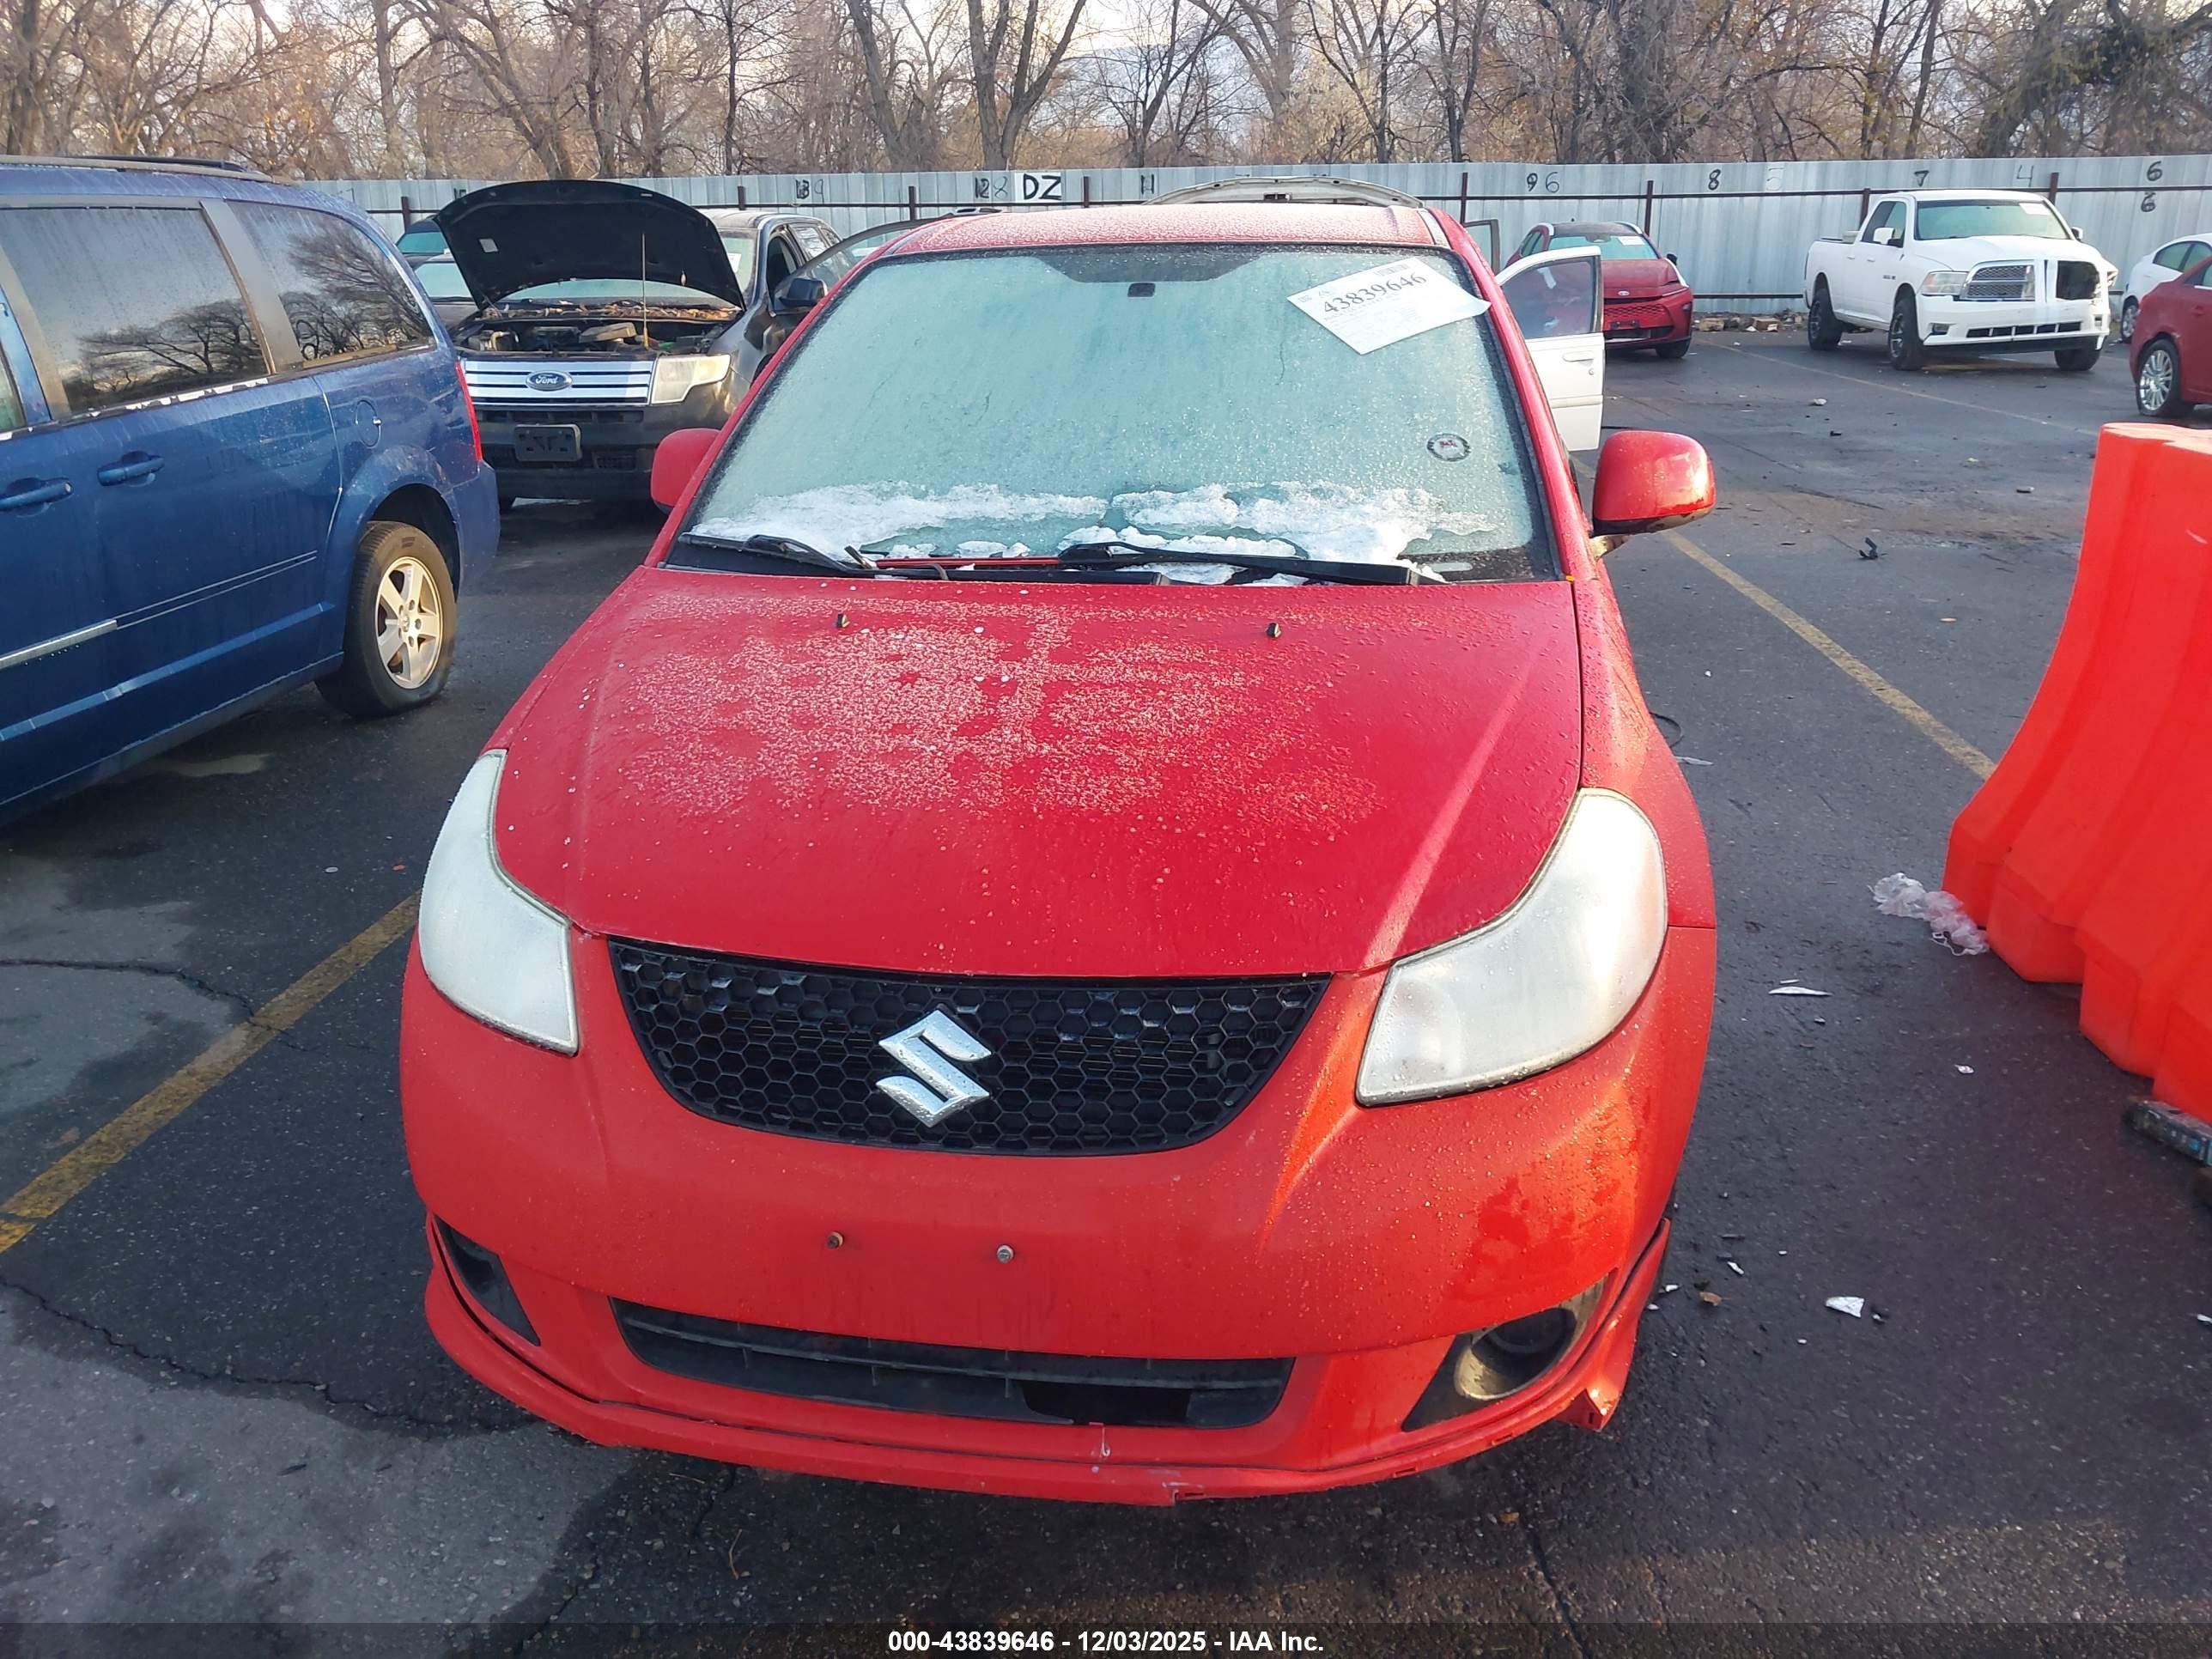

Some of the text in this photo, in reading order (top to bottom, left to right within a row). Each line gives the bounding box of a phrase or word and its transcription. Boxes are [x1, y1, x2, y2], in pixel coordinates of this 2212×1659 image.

[1707, 168, 1722, 191] 8
[1913, 170, 1929, 187] 7
[2016, 164, 2034, 187] 4
[2147, 161, 2163, 182] 6
[1022, 173, 1062, 201] DZ
[1324, 272, 1428, 313] 43839646
[534, 373, 560, 385] Ford
